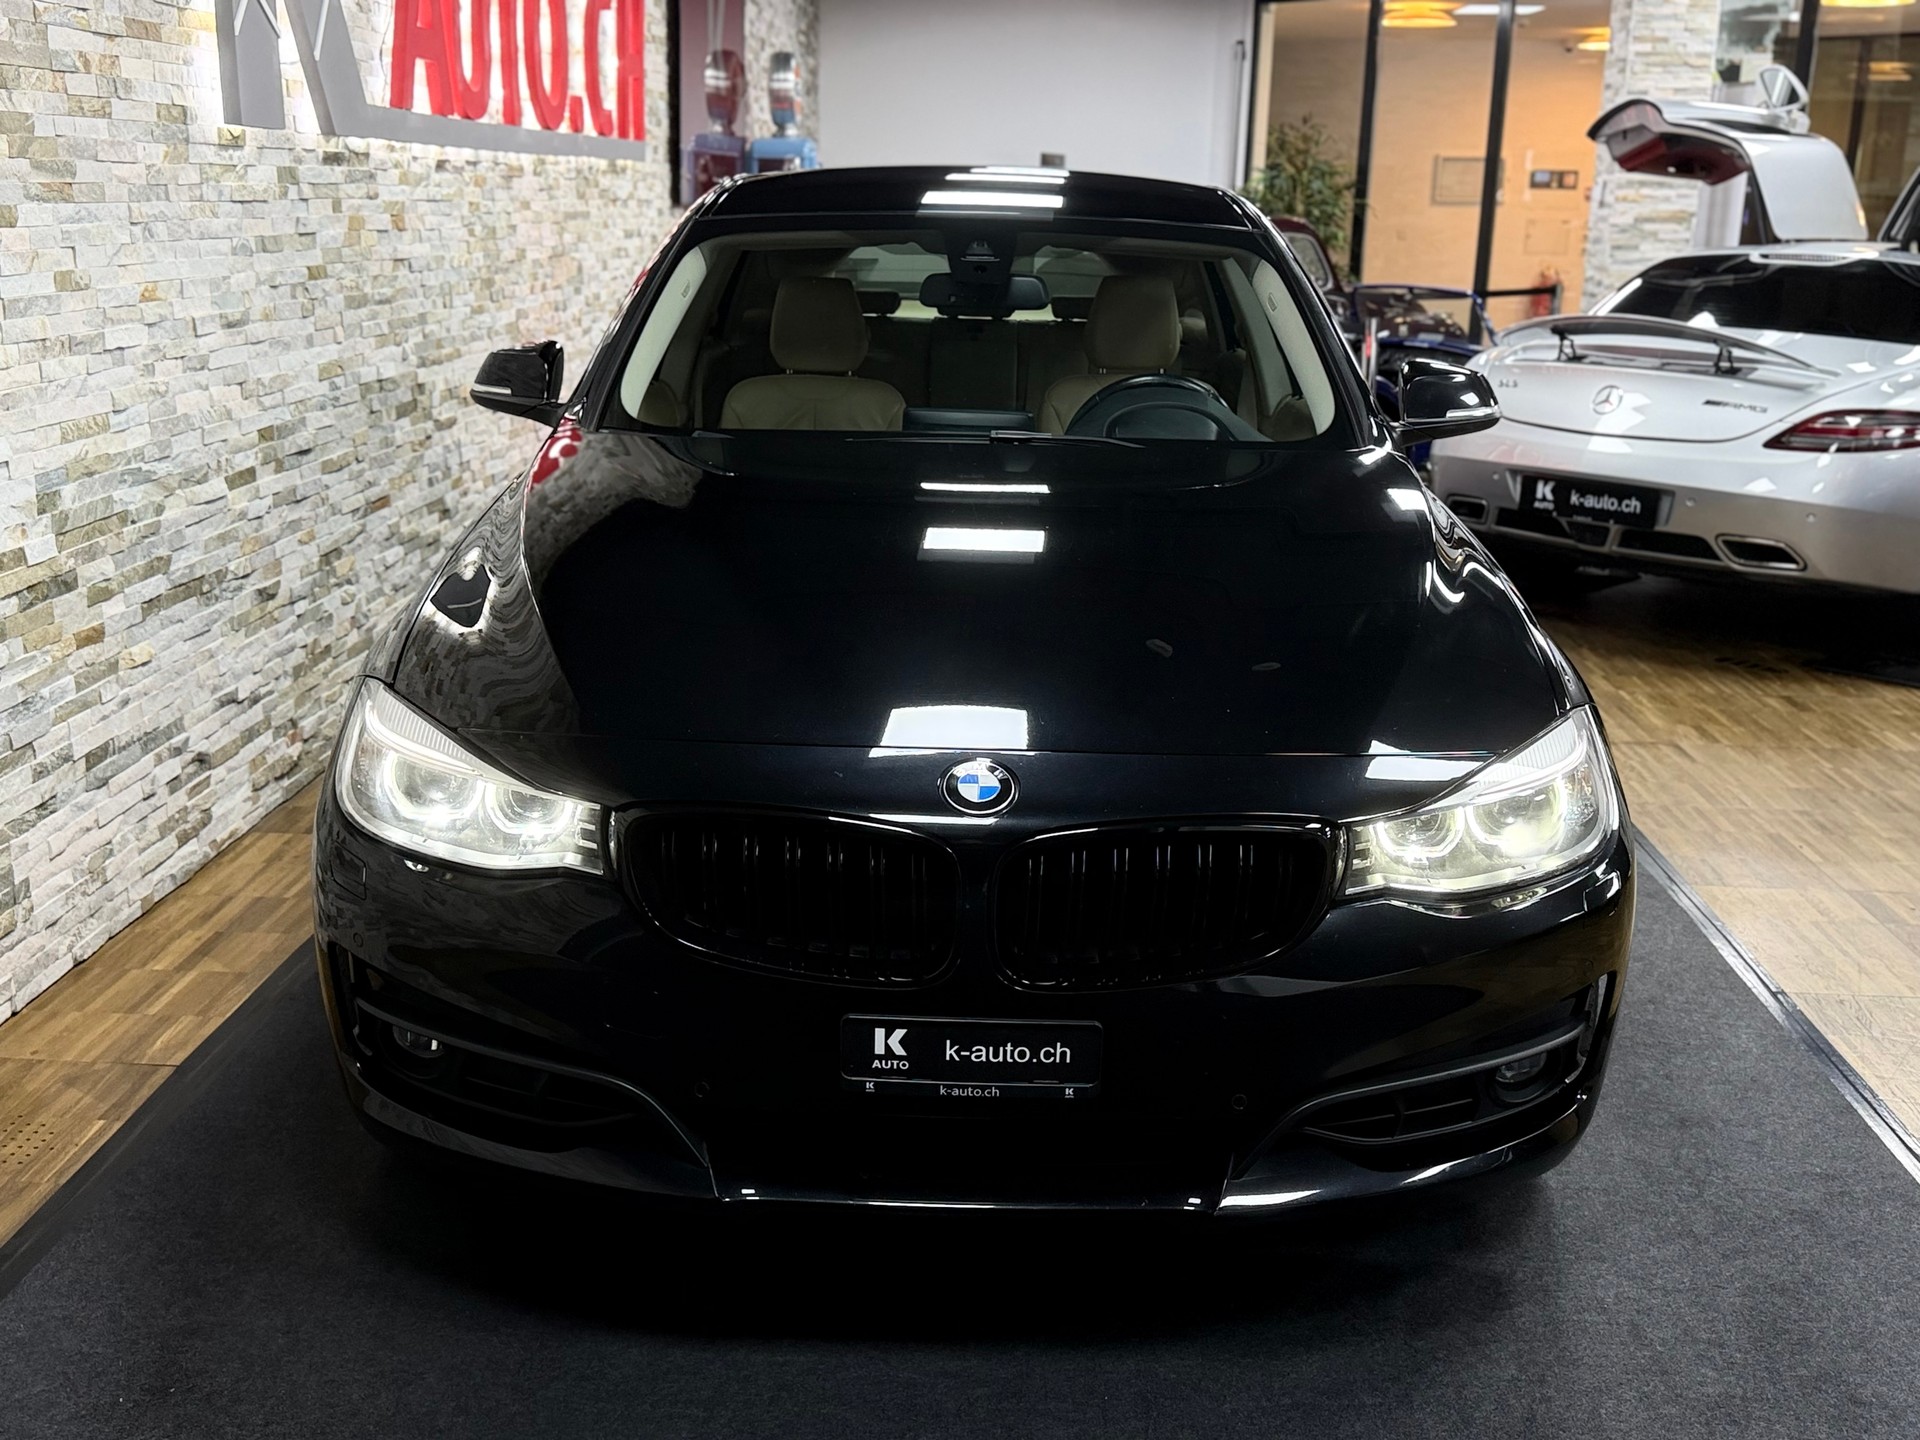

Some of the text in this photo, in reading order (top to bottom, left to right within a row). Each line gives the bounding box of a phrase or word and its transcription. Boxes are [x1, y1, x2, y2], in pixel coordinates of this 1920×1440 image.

[1535, 480, 1556, 501] K
[1569, 488, 1641, 514] k-auto.ch
[874, 1027, 908, 1056] K
[945, 1039, 1071, 1064] k-auto.ch
[872, 1059, 909, 1070] AUTO
[939, 1085, 1000, 1097] k-auto.ch
